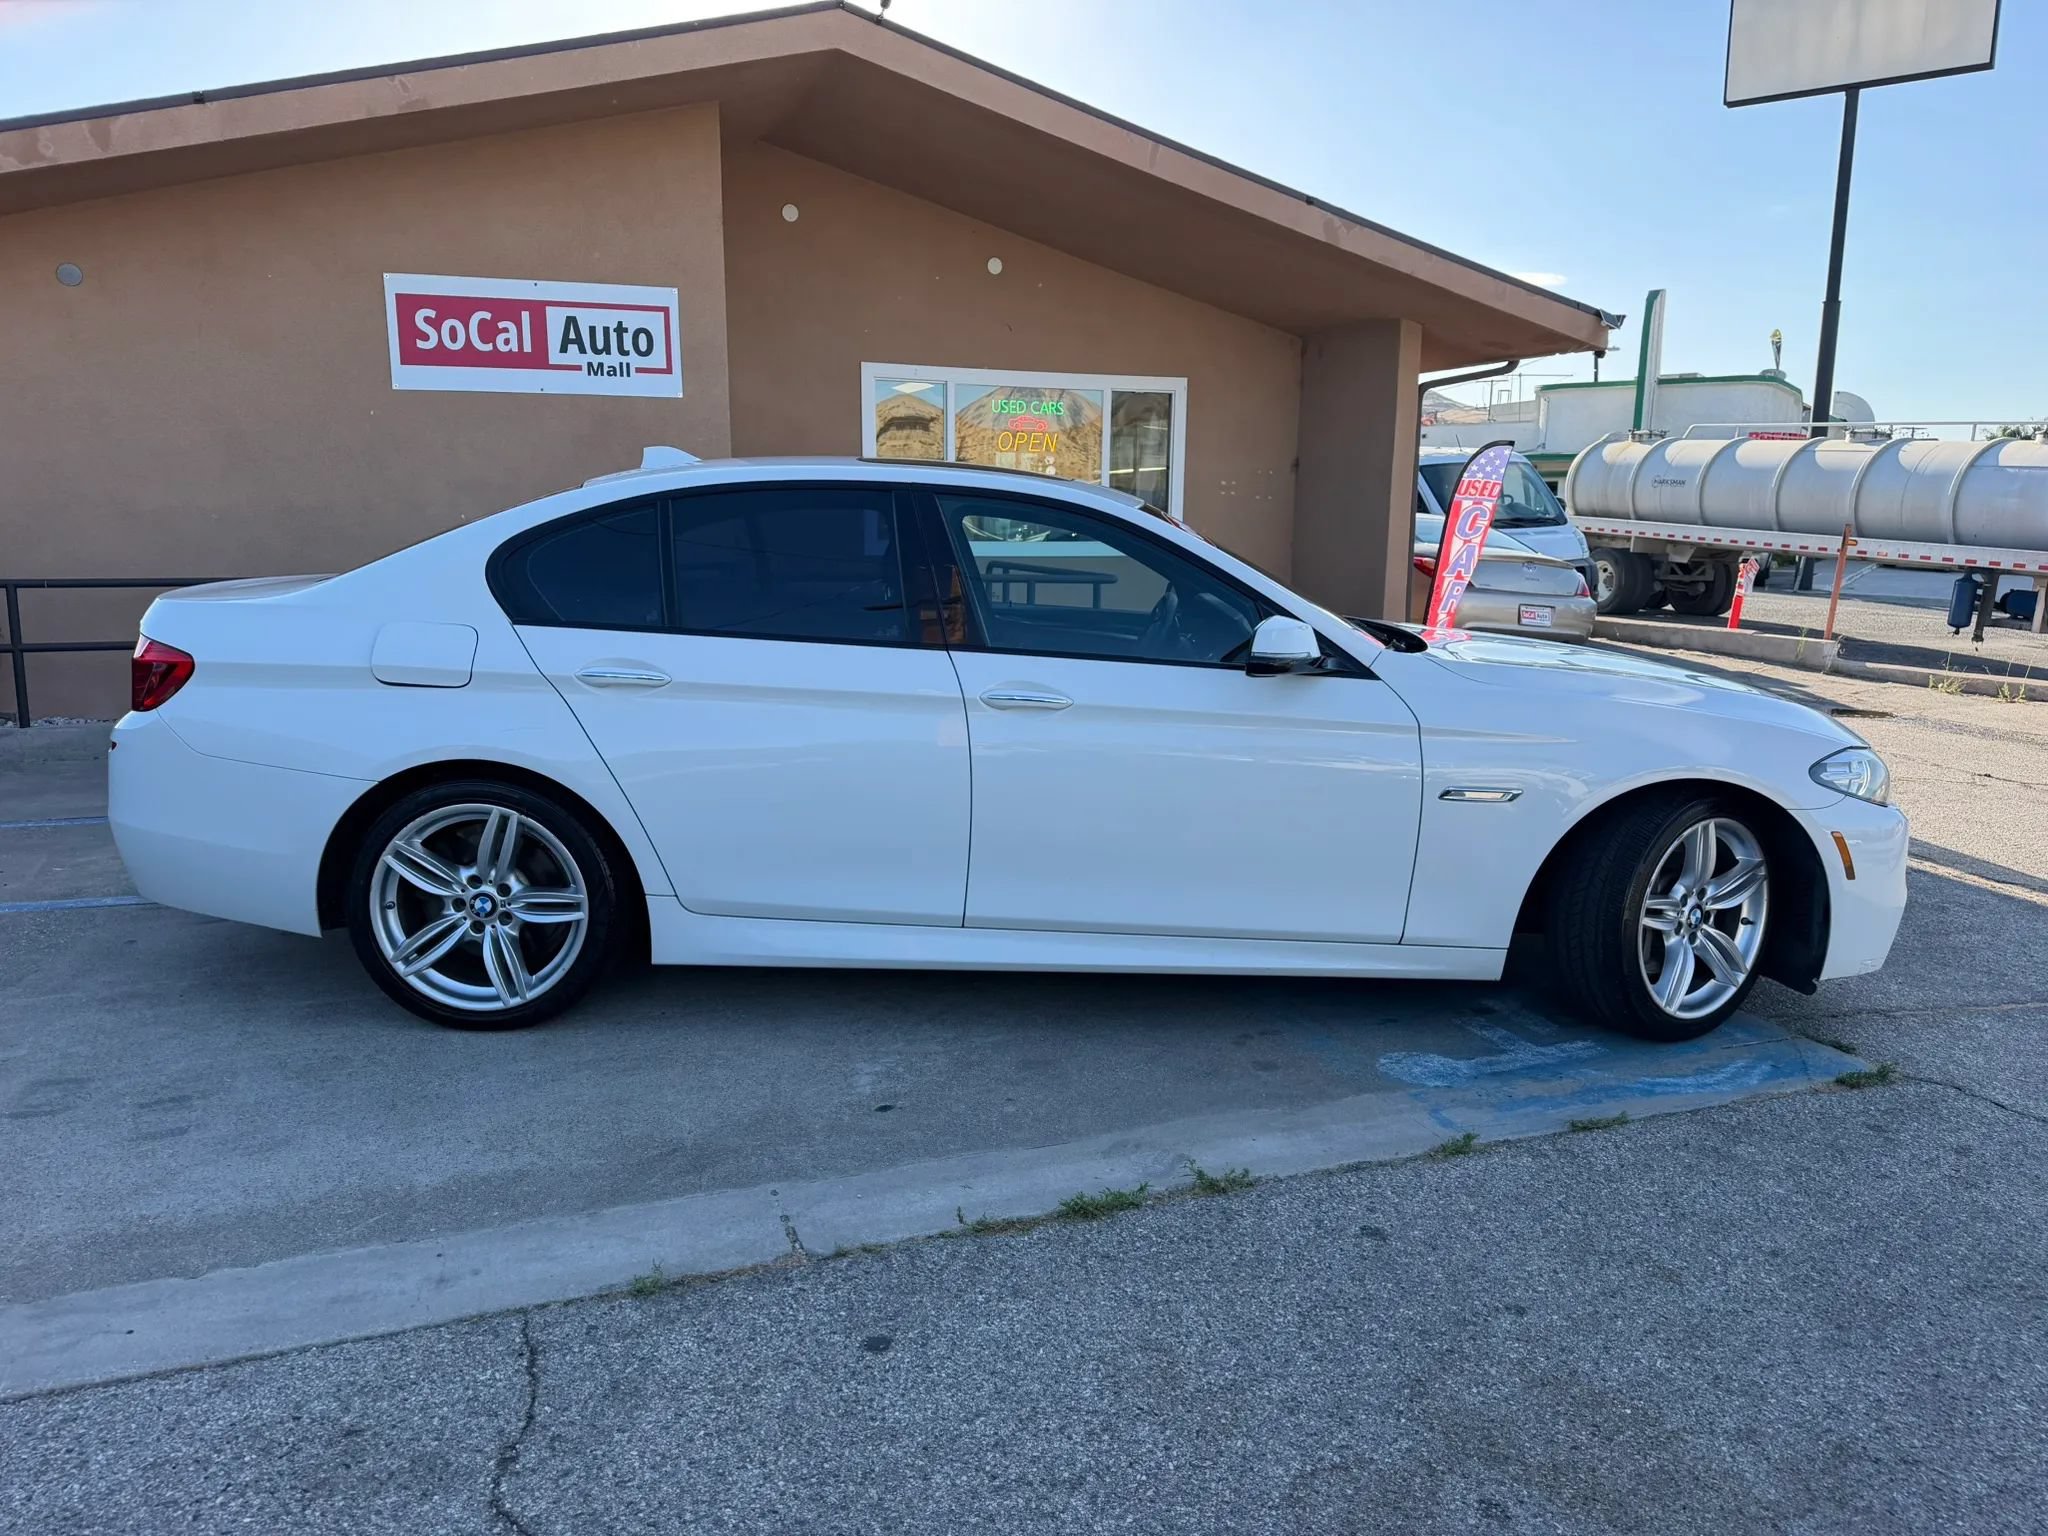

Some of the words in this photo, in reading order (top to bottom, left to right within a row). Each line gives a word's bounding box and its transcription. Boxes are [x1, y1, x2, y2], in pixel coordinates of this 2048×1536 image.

[414, 308, 532, 353] SoCal
[558, 315, 654, 358] Auto
[586, 361, 631, 378] Mall
[992, 399, 1026, 414] USED
[1031, 401, 1064, 416] CARS
[998, 431, 1058, 452] OPEN
[1457, 479, 1502, 499] USED
